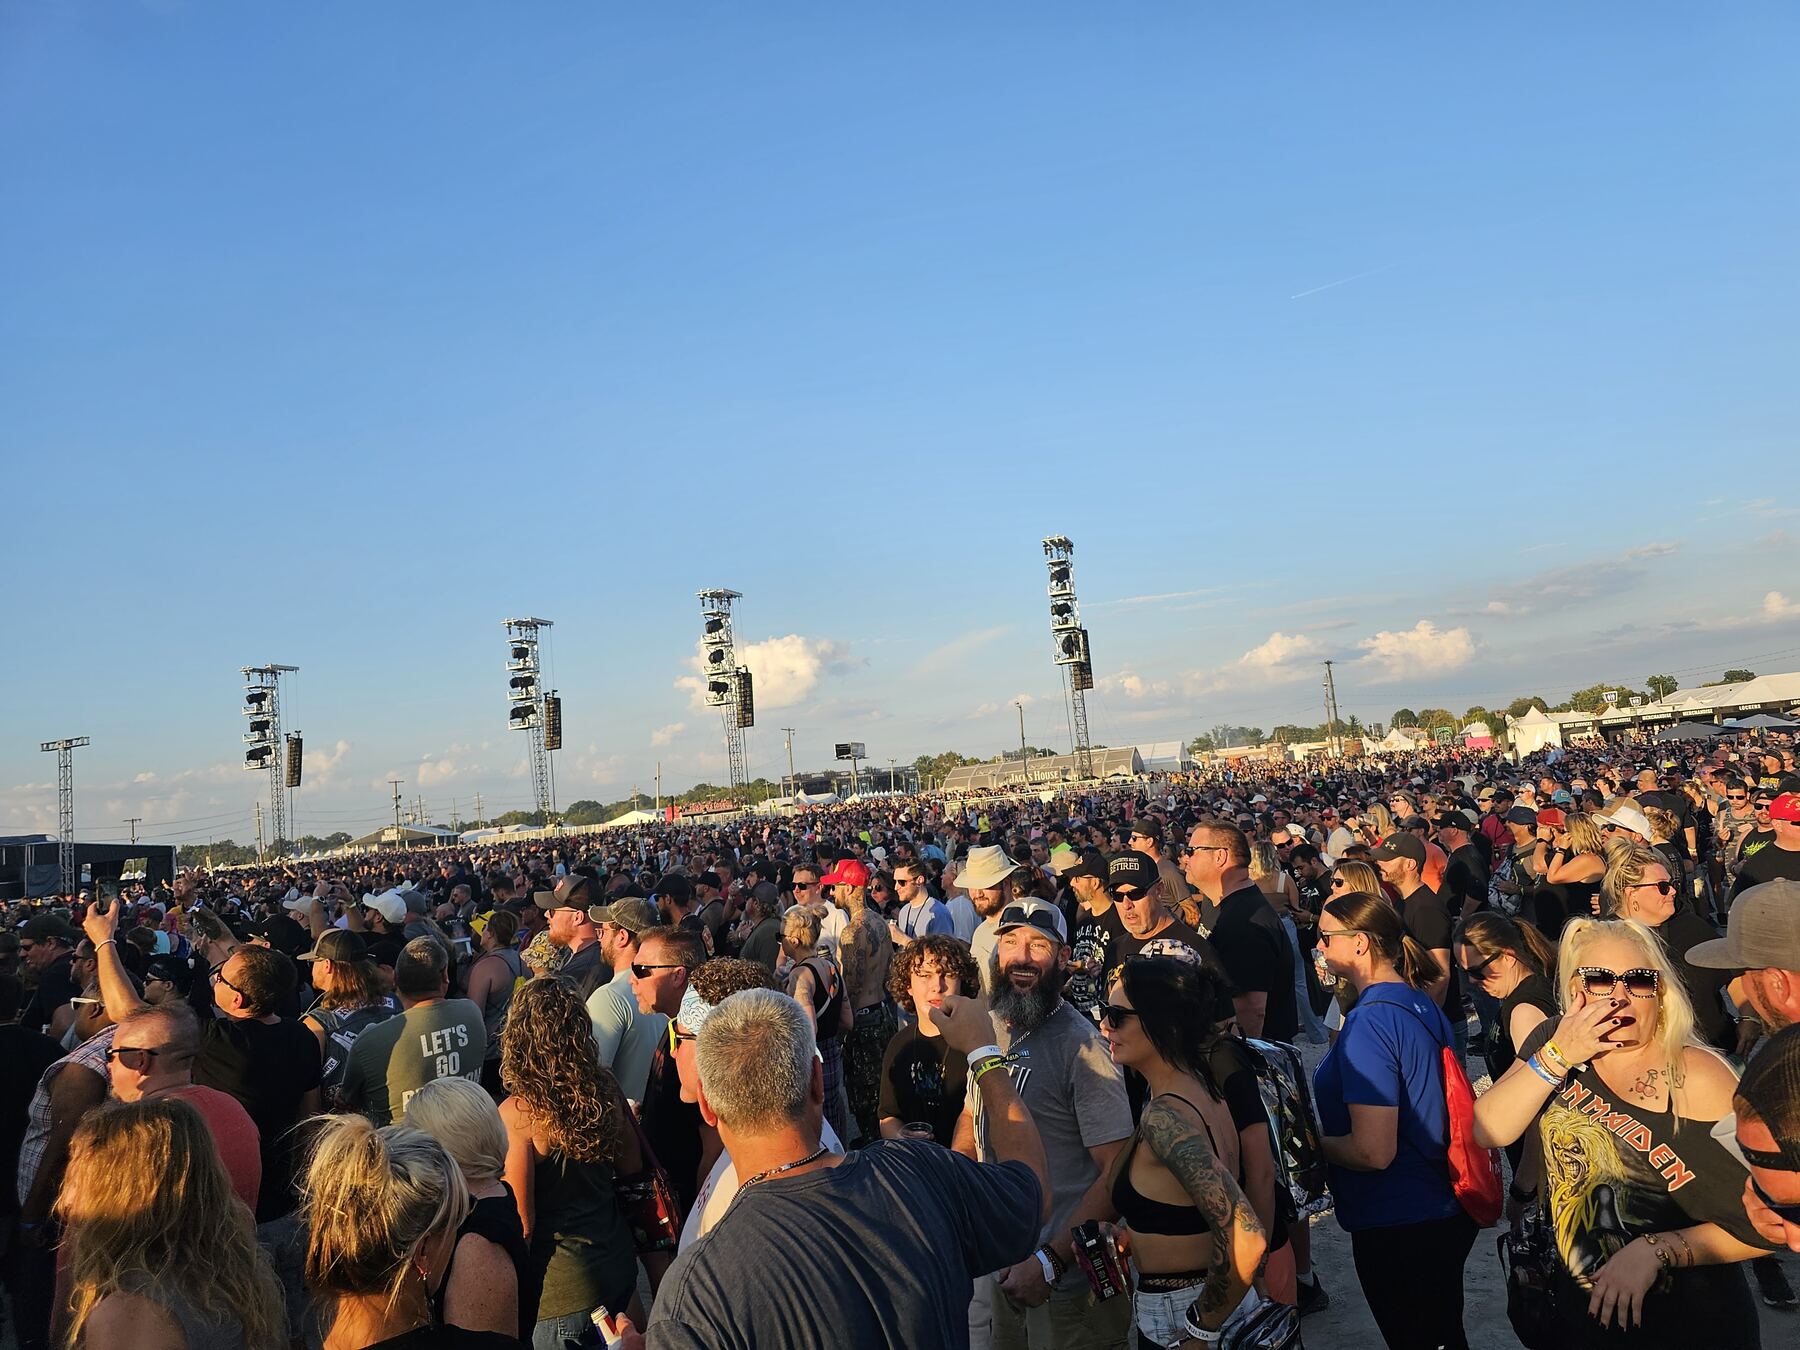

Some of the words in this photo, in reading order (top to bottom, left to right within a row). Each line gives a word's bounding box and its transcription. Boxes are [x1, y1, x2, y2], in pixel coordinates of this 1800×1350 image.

[1682, 708, 1713, 716] MERCHANDISE
[1602, 717, 1632, 725] MERCHANDISE
[1034, 770, 1059, 781] HOUSE
[1110, 862, 1140, 875] RETIRED
[420, 1024, 469, 1058] LET'S
[436, 1051, 460, 1078] GO
[1581, 1094, 1697, 1192] MAIDEN
